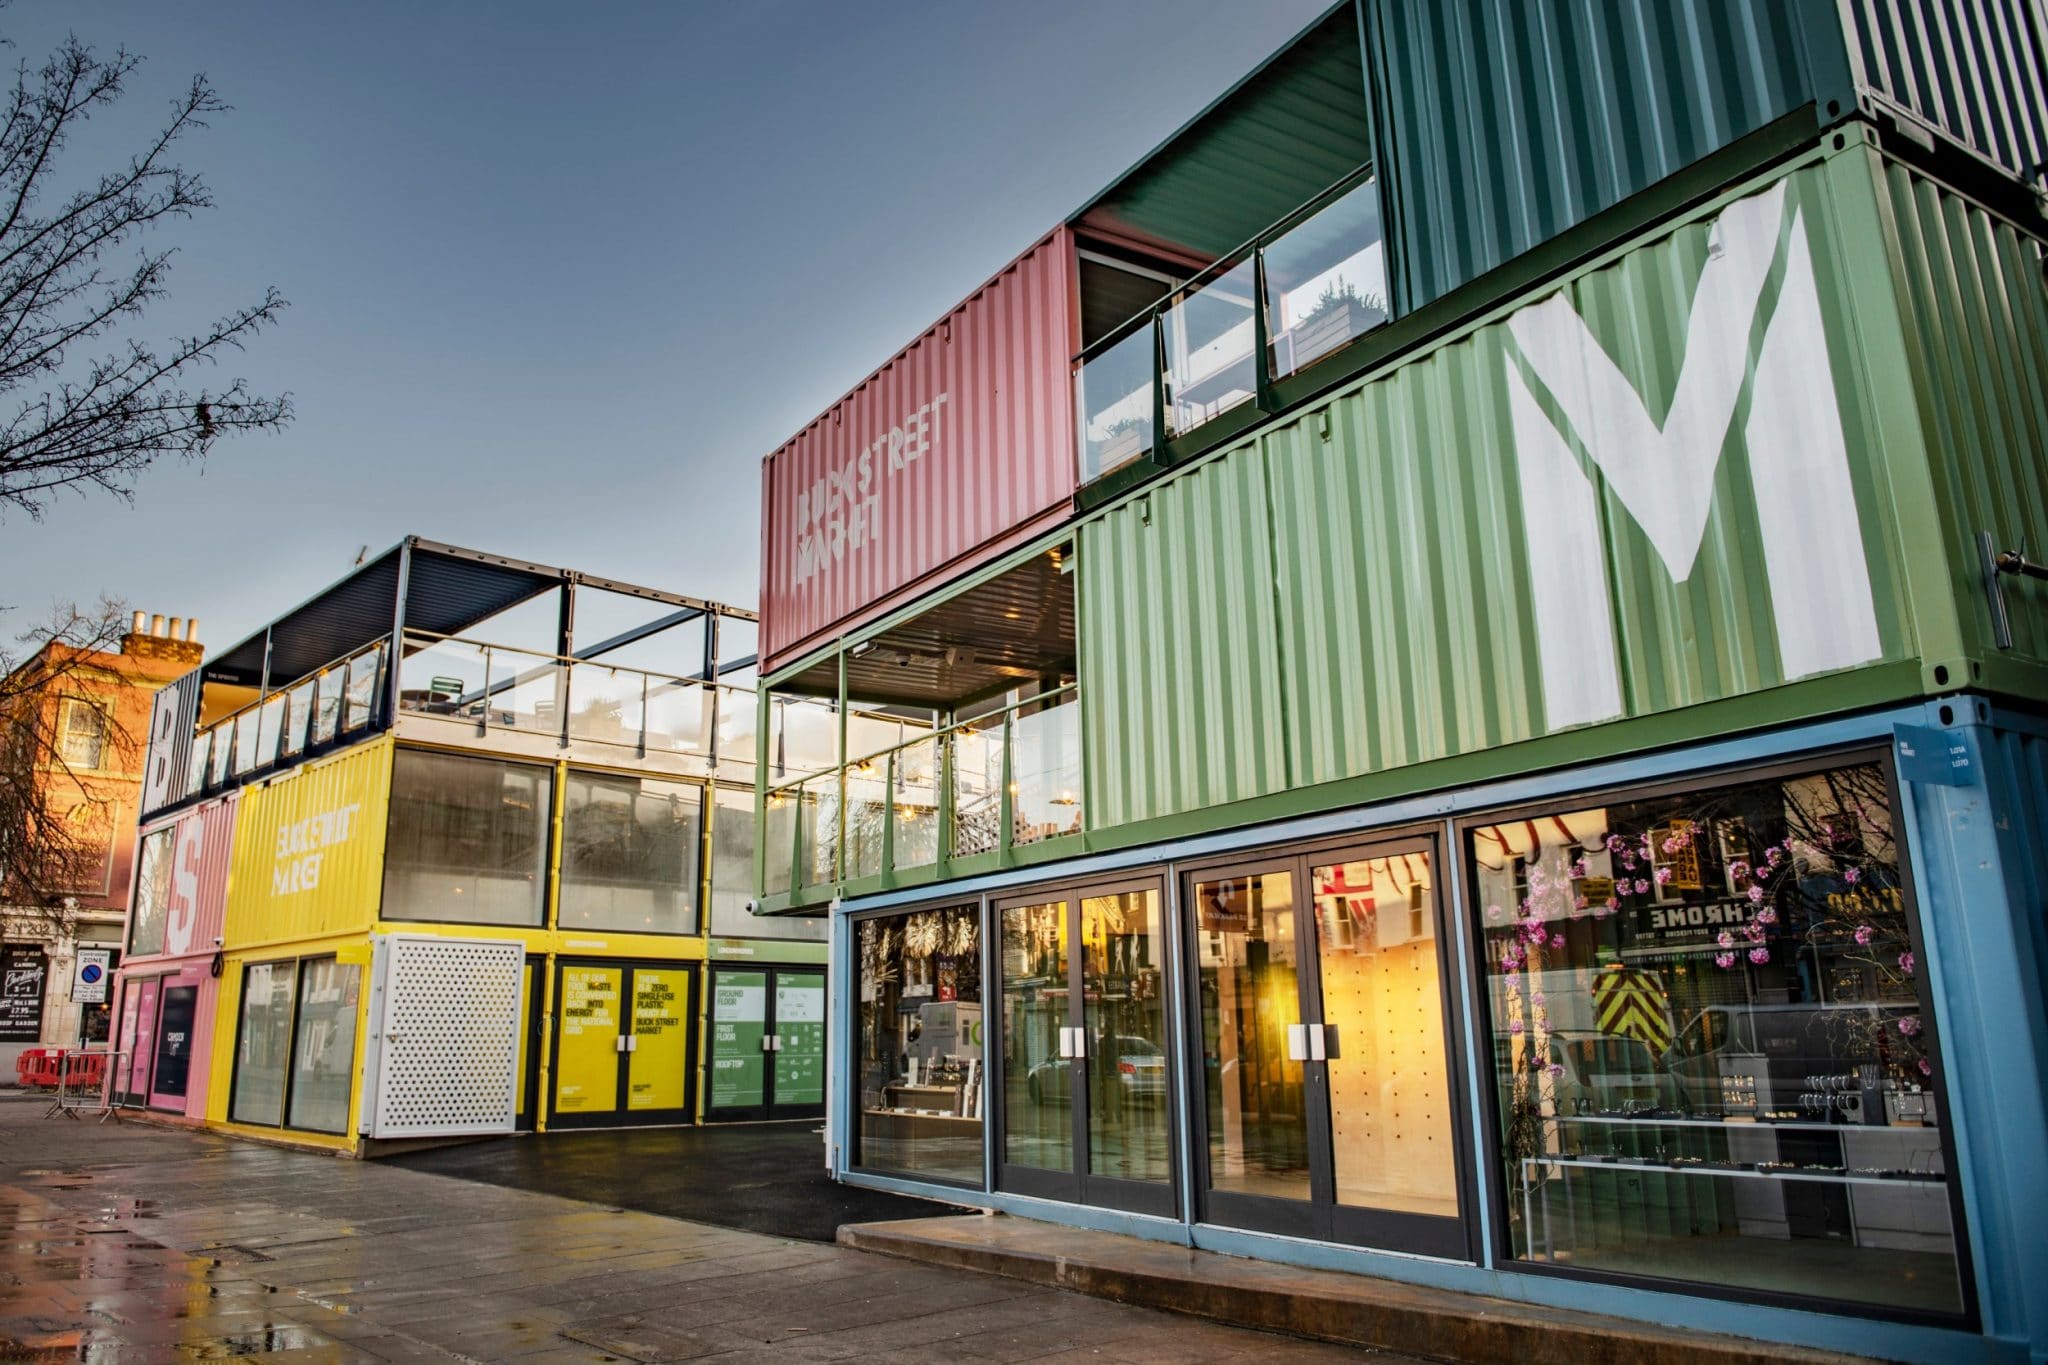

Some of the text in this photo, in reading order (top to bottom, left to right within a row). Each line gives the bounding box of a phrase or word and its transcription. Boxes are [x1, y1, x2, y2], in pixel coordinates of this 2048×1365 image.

[857, 391, 948, 496] STREET
[1504, 178, 1882, 732] M
[166, 816, 205, 956] S
[587, 982, 612, 991] WASTE
[651, 984, 669, 992] ZERO
[637, 992, 675, 1000] SINGLE-USE
[717, 989, 744, 998] GROUND
[587, 1000, 604, 1008] INTO
[637, 1000, 664, 1009] PLASTIC
[717, 998, 737, 1006] FLOOR
[566, 1008, 593, 1016] ENERGY
[636, 1017, 679, 1026] BUCK STREET
[635, 1026, 662, 1035] MARKET
[716, 1024, 735, 1033] FIRST
[716, 1032, 737, 1041] FLOOR
[715, 1060, 745, 1069] ROOFTOP
